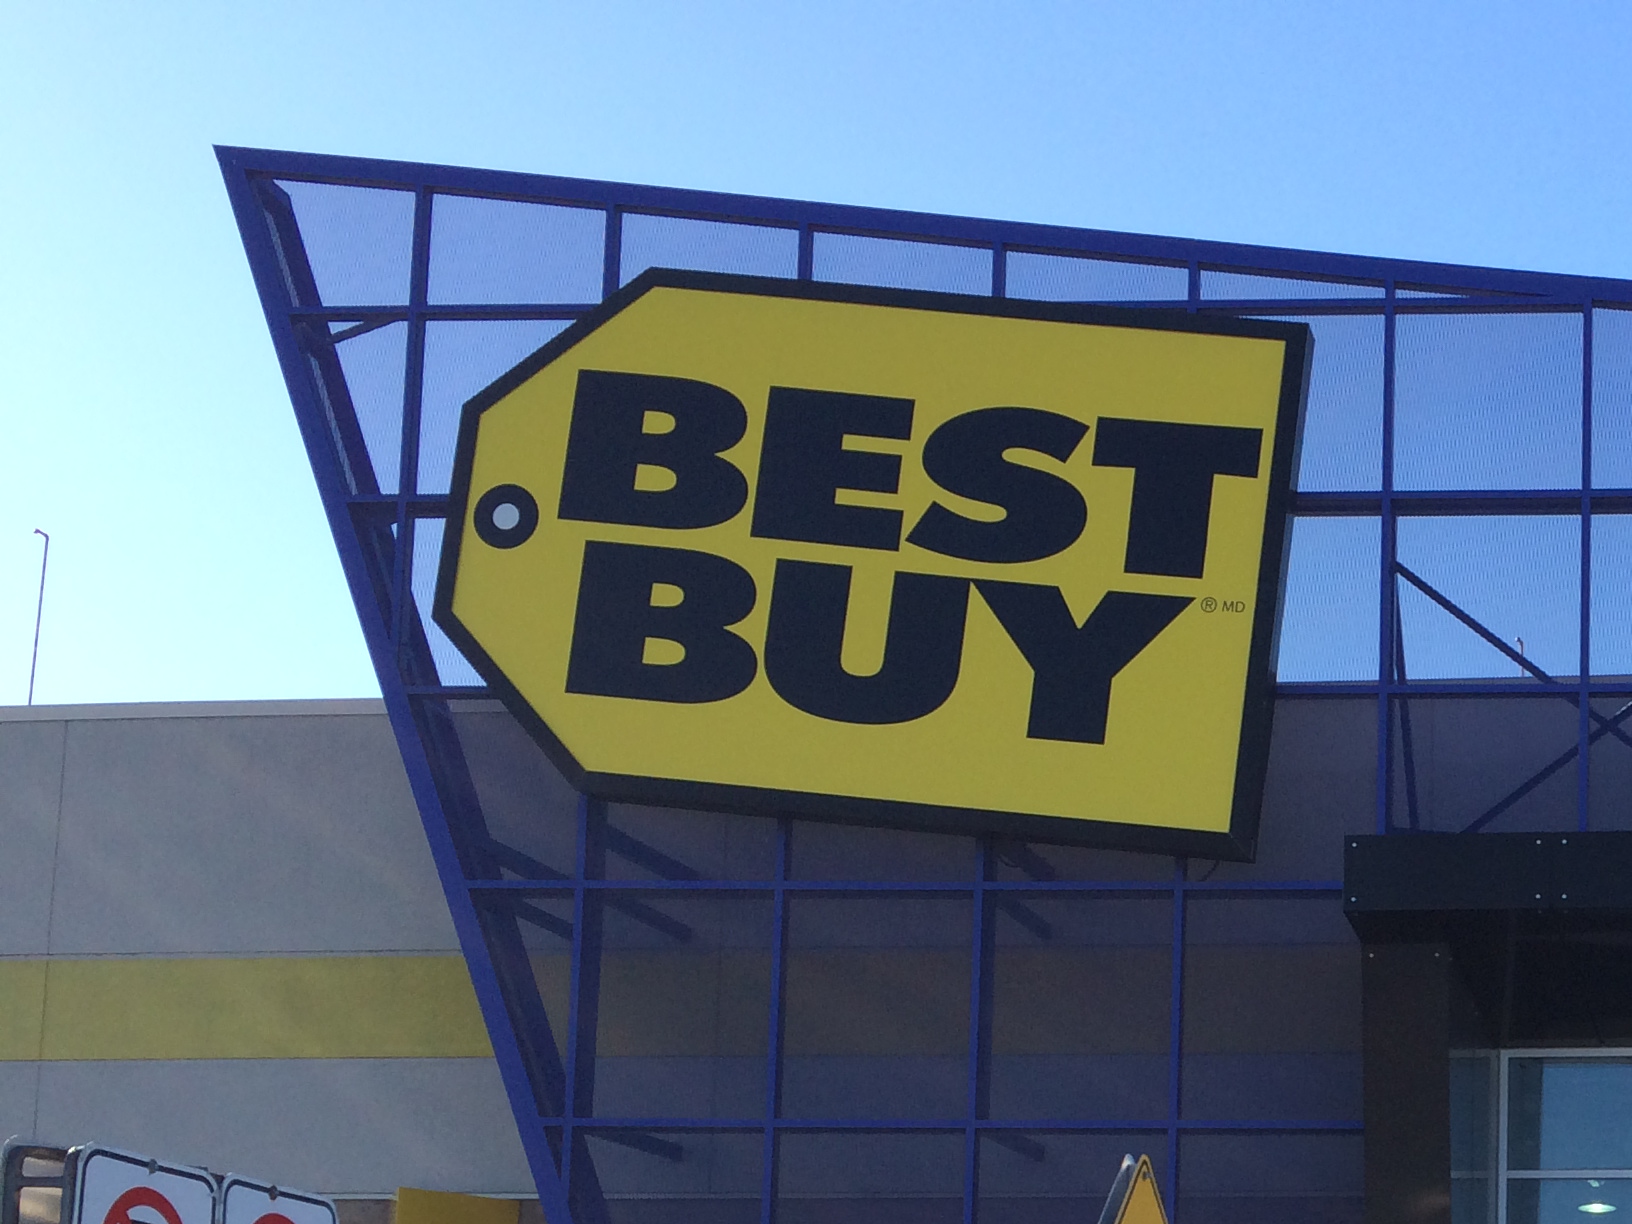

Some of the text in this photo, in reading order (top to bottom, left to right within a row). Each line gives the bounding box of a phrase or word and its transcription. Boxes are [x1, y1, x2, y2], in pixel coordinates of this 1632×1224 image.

[558, 370, 1263, 579] BEST
[565, 539, 1197, 745] BUY
[1221, 600, 1246, 613] MD
